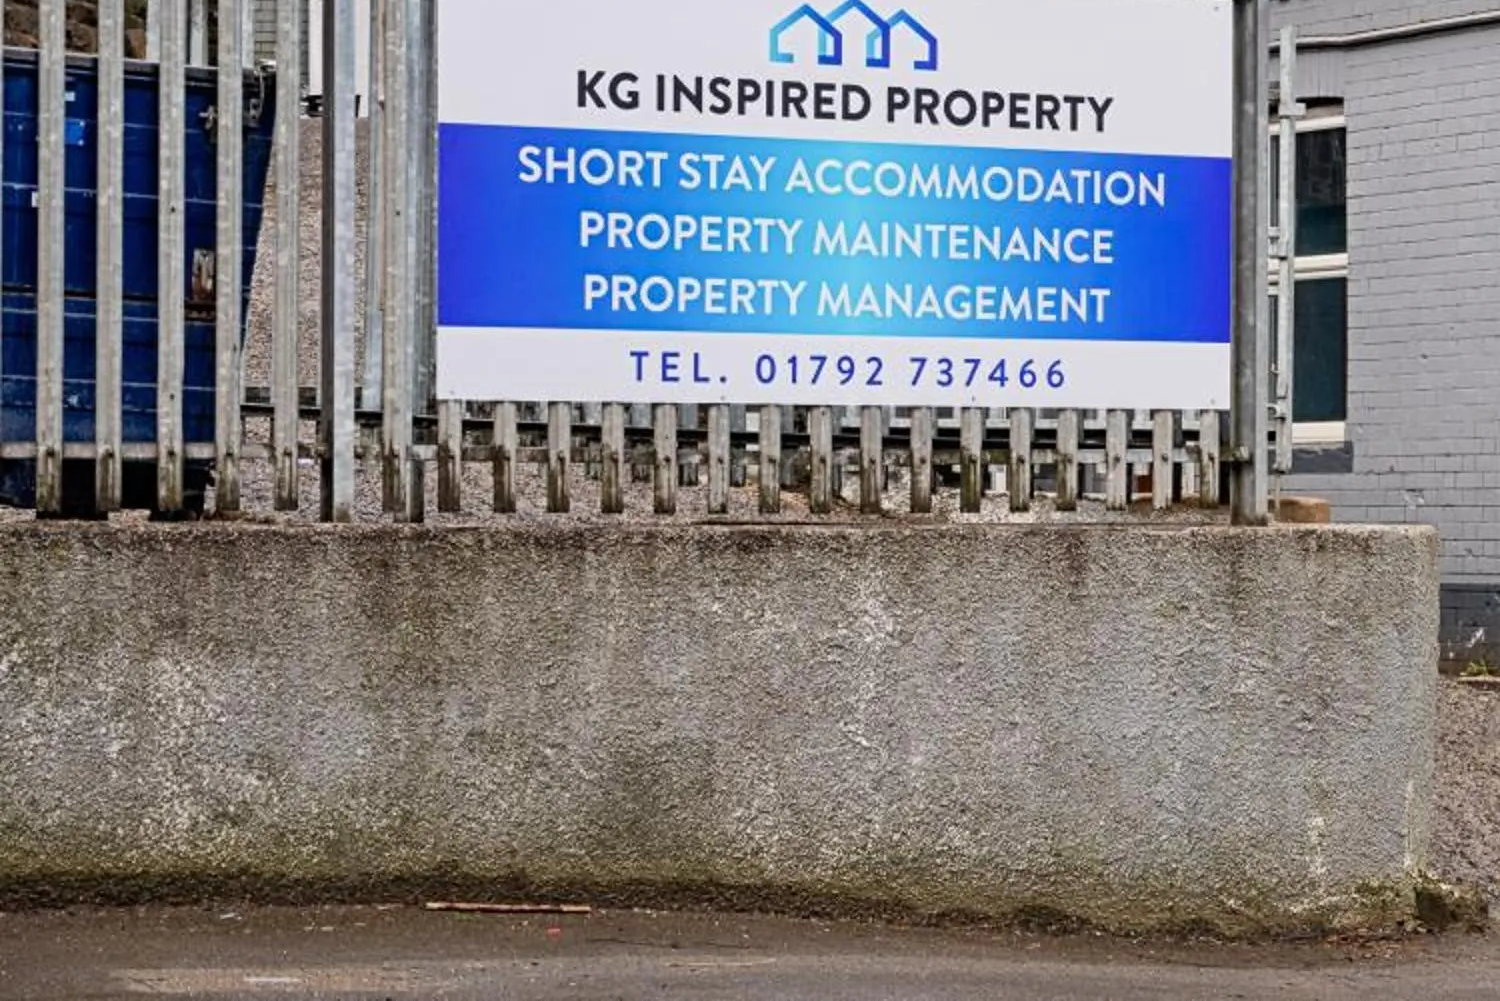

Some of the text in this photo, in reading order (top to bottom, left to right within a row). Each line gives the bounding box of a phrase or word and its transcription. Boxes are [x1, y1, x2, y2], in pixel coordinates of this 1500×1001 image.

[578, 70, 1114, 132] KG INSPIRED PROPERTY
[518, 146, 1166, 206] SHORT STAY ACCOMMODATION
[581, 212, 1113, 263] PROPERTY MAINTENANCE
[585, 275, 1110, 322] PROPERTY MANAGEMENT
[630, 350, 1065, 389] TEL. 01792 737466
